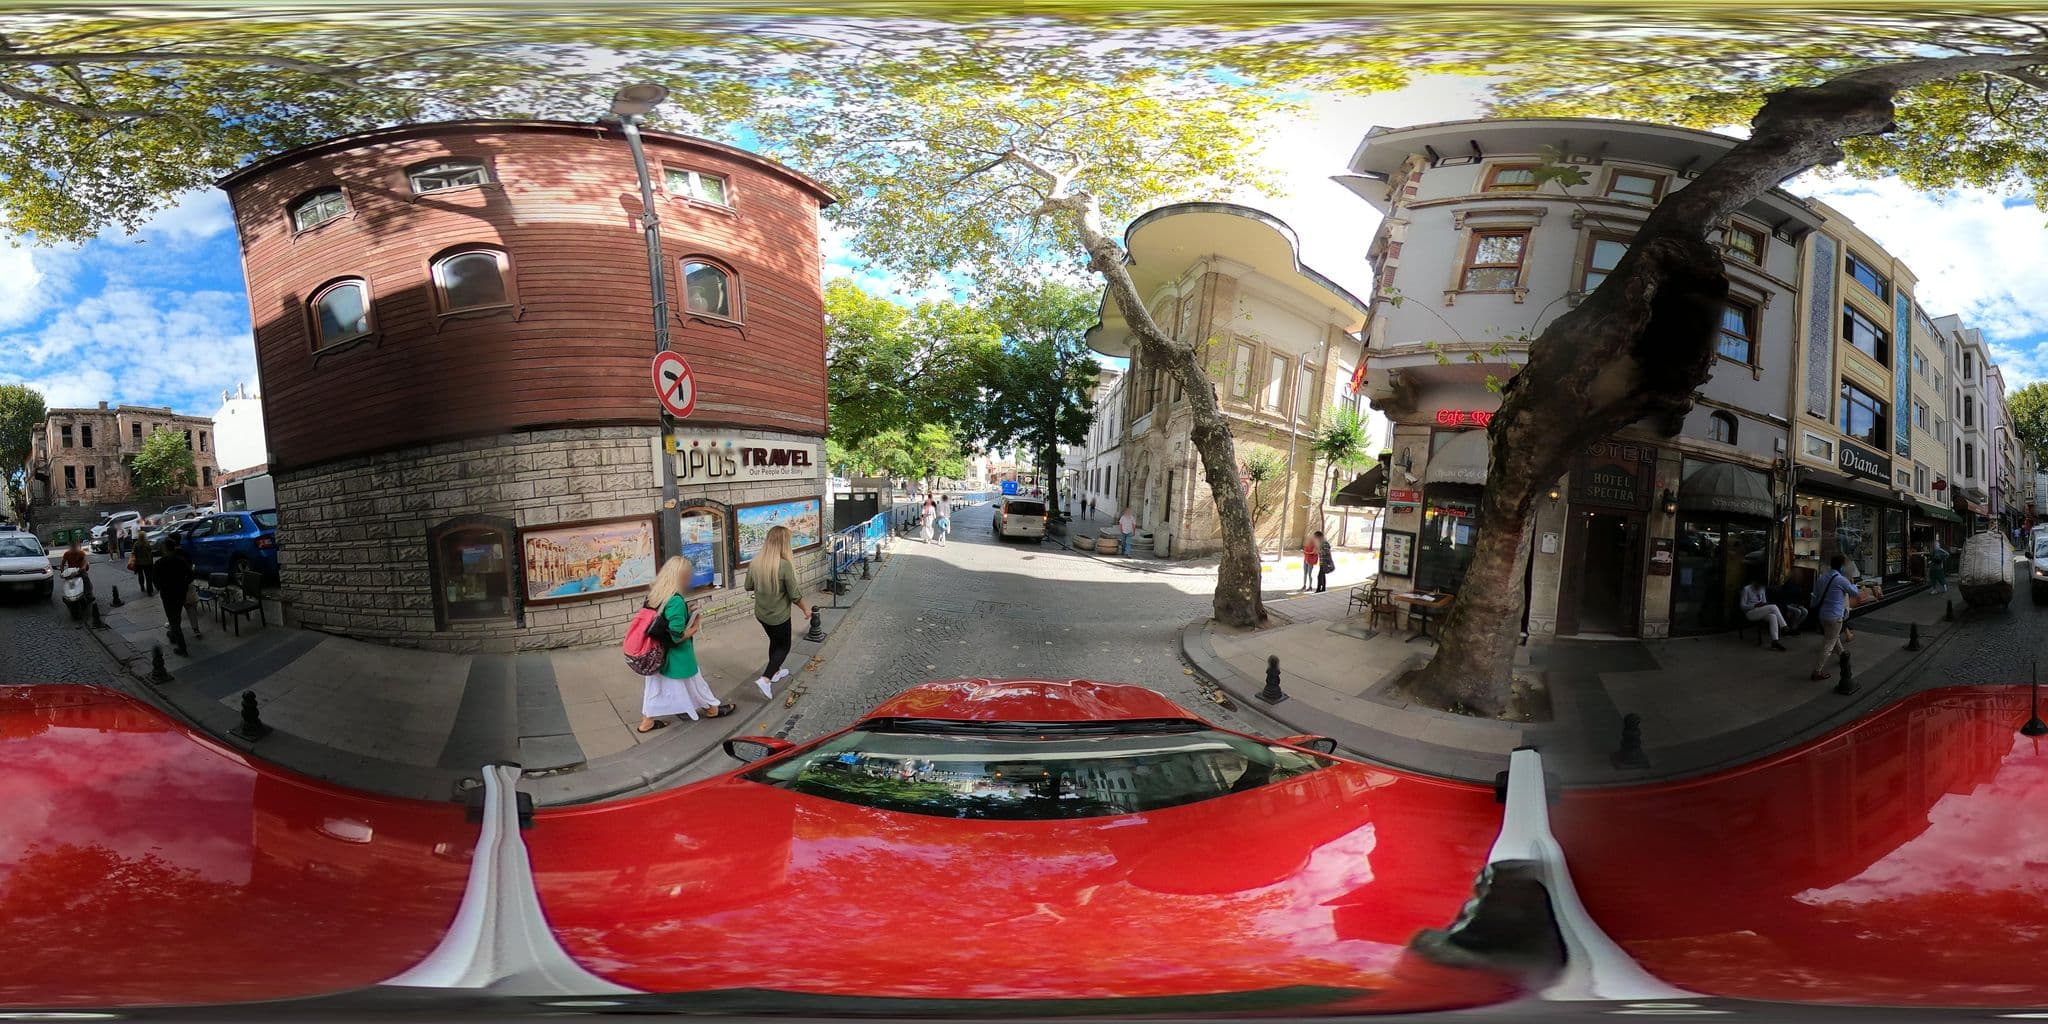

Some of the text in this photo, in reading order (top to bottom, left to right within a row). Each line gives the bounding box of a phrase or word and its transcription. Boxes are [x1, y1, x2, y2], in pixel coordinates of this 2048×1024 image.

[1436, 409, 1493, 427] Cafe Re
[741, 447, 812, 466] TRAVEL
[1840, 448, 1878, 476] Diana
[749, 468, 760, 476] Our
[761, 468, 779, 477] People
[1593, 472, 1630, 488] HOTEL
[1585, 486, 1634, 502] SPECTRA
